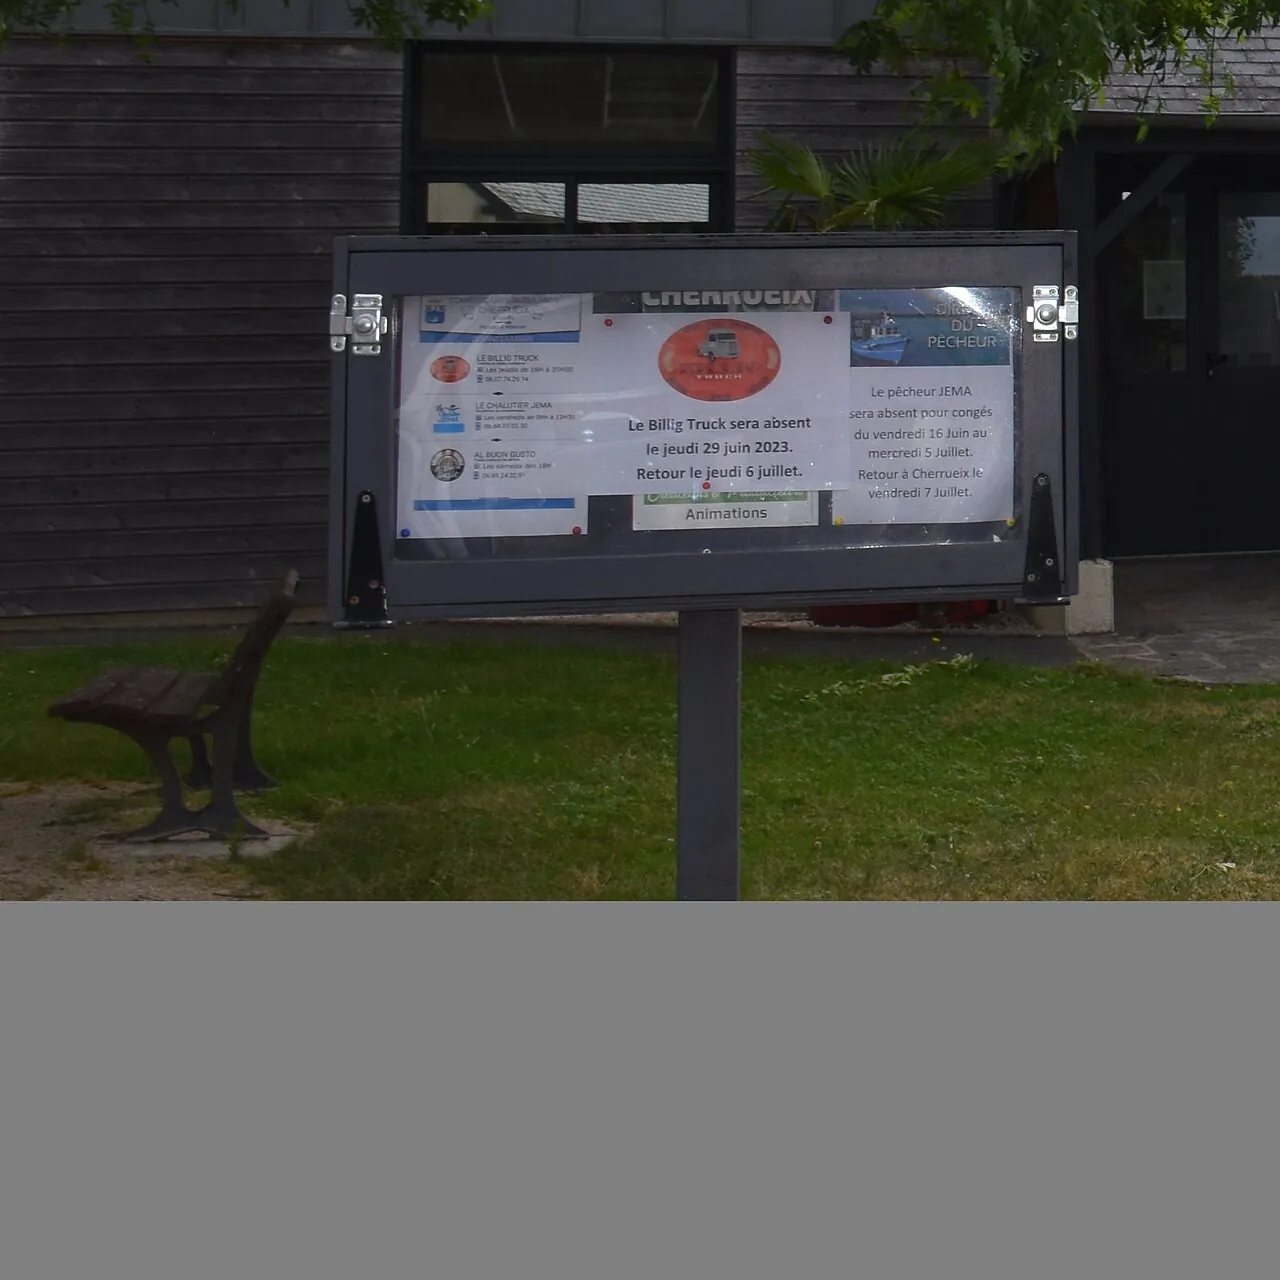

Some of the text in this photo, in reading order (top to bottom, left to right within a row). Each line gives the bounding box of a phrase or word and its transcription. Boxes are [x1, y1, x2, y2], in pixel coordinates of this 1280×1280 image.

[951, 319, 972, 332] DU
[477, 354, 539, 362] LE BILLIG TRUCK
[871, 386, 973, 399] Le pêcheur JEMA
[476, 402, 552, 410] LE CHALUTIER JEMA
[848, 406, 993, 420] sera absent pour congés
[628, 417, 811, 433] Le Billig Truck sera absent
[854, 428, 987, 440] du vendredi 16 Juin au
[474, 451, 536, 459] AL BUON GUSTO
[646, 441, 793, 458] le jeudi 29 juin 2023.
[868, 447, 973, 459] mercredi 5 Juillet.
[637, 465, 803, 481] Retour le jeudi 6 juillet.
[858, 468, 984, 480] Retour à Cherrueix le
[868, 487, 972, 499] vendredi 7 Juillet.
[685, 507, 768, 521] Animations
